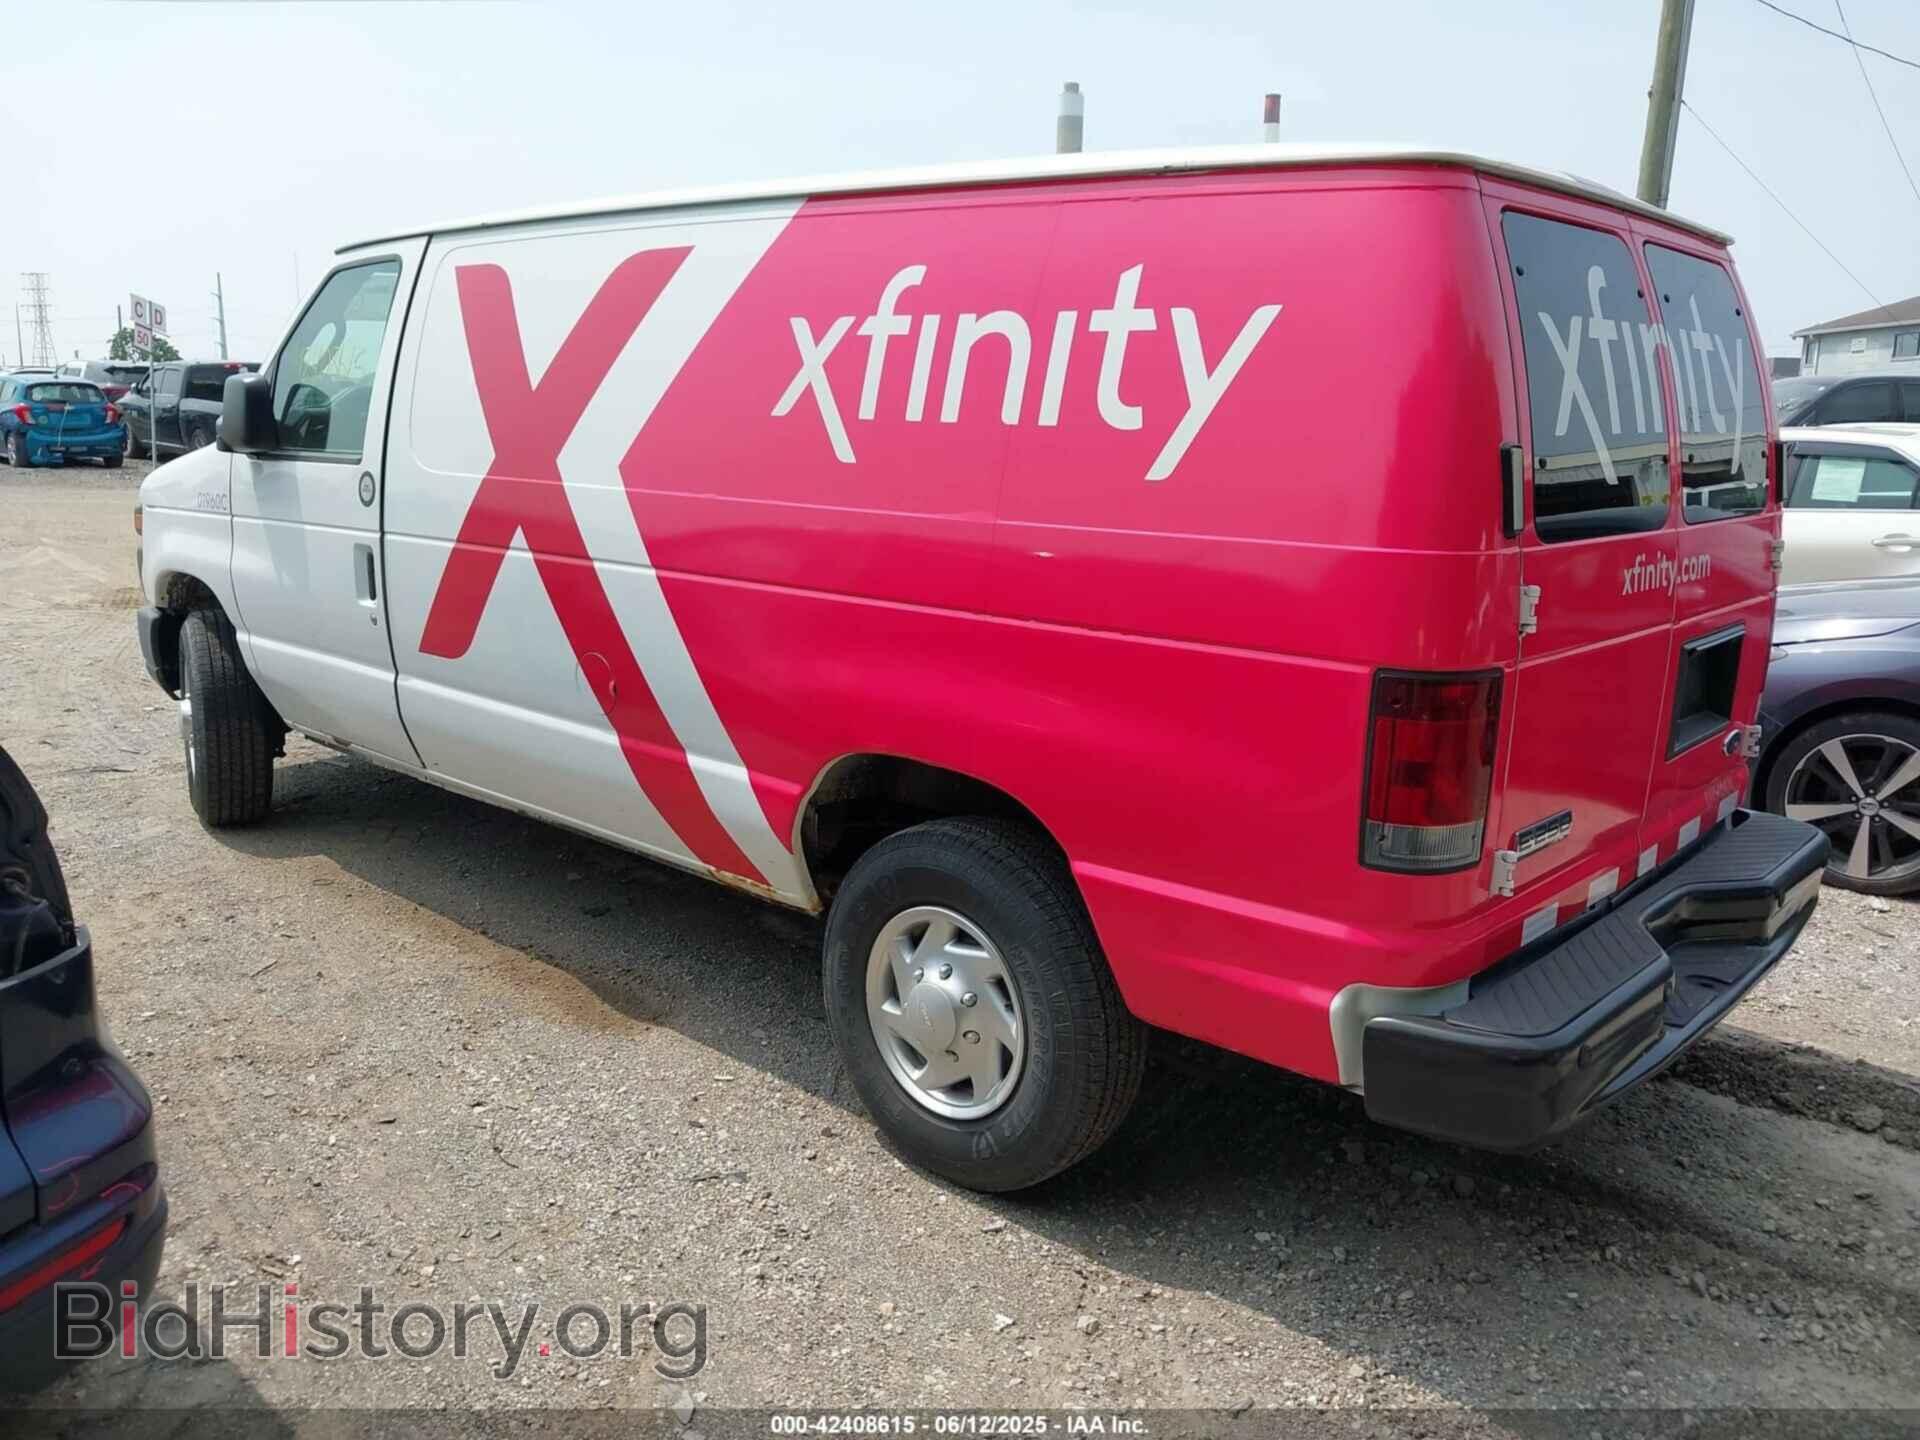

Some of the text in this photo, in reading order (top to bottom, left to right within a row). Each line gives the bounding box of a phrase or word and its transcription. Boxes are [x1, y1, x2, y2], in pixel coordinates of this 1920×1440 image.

[134, 301, 144, 318] C
[154, 308, 163, 326] D
[770, 263, 1283, 481] xfinity
[1537, 265, 1743, 485] xfinity
[1622, 550, 1711, 597] xfinity.com
